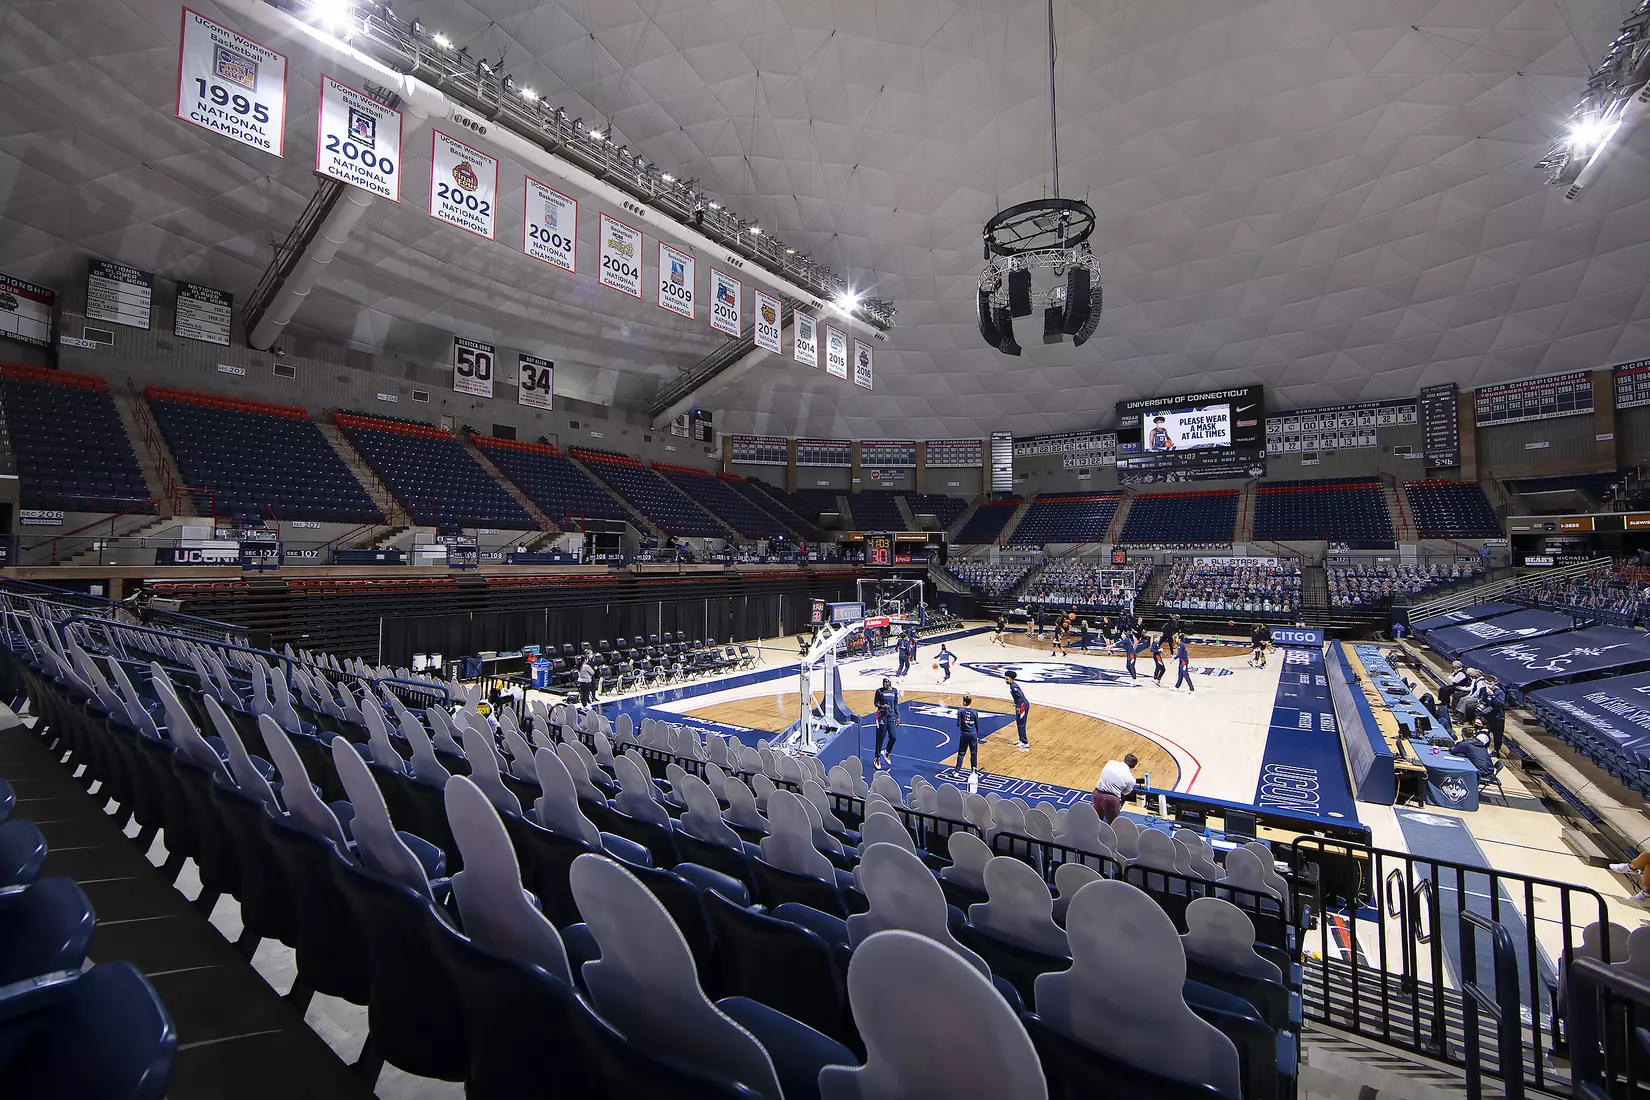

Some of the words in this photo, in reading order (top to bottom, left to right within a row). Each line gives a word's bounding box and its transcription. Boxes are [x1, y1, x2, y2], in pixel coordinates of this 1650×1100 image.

[195, 16, 230, 38] UConn
[233, 35, 277, 61] Women's
[210, 33, 263, 63] Basketball
[195, 78, 269, 123] 1995
[330, 81, 357, 99] UConn
[360, 95, 394, 117] Women's
[342, 96, 383, 119] Basketball
[197, 102, 265, 135] NATIONAL
[190, 112, 270, 148] CHAMPIONS
[326, 134, 394, 174] 2000
[440, 135, 462, 149] UConn
[464, 146, 492, 164] Women's
[450, 147, 483, 167] Basketball
[334, 157, 386, 184] NATIONAL
[454, 170, 474, 183] Final
[328, 166, 390, 196] CHAMPIONS
[458, 179, 477, 191] Four
[438, 183, 490, 216] 2002
[531, 181, 548, 194] UConn
[550, 190, 572, 204] Women's
[538, 192, 565, 207] Basketball
[442, 202, 485, 224] NATIONAL
[438, 210, 487, 234] CHAMPIONS
[604, 217, 619, 228] UConn
[529, 224, 571, 252] 2003
[611, 226, 633, 239] Basketball
[533, 241, 567, 260] NATIONAL
[530, 249, 570, 268] CHAMPIONS
[101, 262, 141, 276] NATIONAL
[106, 269, 137, 279] PLAYER
[603, 255, 638, 280] 2004
[108, 273, 124, 281] THE
[127, 278, 147, 287] YEAR
[606, 271, 635, 286] NATIONAL
[188, 284, 222, 296] NATIONAL
[604, 278, 637, 294] CHAMPIONS
[661, 281, 691, 302] 2009
[192, 289, 219, 299] PLAYER
[665, 295, 689, 309] NATIONAL
[663, 302, 690, 317] CHAMPIONS
[714, 303, 737, 321] 2010
[713, 321, 737, 335] CHAMPIONS
[715, 316, 736, 328] NATIONAL
[758, 323, 778, 338] 2013
[7, 333, 48, 347] BASKETBALL
[75, 339, 95, 349] 206
[797, 339, 815, 353] 2014
[457, 348, 491, 380] 50
[829, 353, 844, 366] 2015
[229, 367, 245, 375] 207
[856, 366, 871, 378] 2016
[521, 364, 551, 395] 34
[1481, 385, 1505, 393] NCAA
[1509, 373, 1585, 389] CHAMPIONSHIP
[1480, 387, 1527, 397] TOURNAMENT
[1530, 378, 1586, 390] APPEARANCES
[1507, 393, 1521, 401] 2003
[1540, 388, 1555, 396] 2005
[1126, 398, 1173, 409] UNIVERSITY
[1174, 396, 1186, 404] OF
[1187, 389, 1248, 402] CONNECTICUT
[1508, 401, 1521, 409] 2012
[1524, 399, 1538, 407] 2014
[1179, 416, 1204, 426] PLEASE
[1205, 414, 1227, 423] WEAR
[1322, 420, 1334, 428] 13
[1362, 417, 1371, 425] 34
[1382, 415, 1391, 423] 32
[1402, 413, 1412, 421] 50
[1181, 432, 1191, 440] AT
[1192, 431, 1204, 439] ALL
[1205, 429, 1226, 438] TIMES
[1190, 424, 1196, 432] A
[1197, 423, 1216, 431] MASK
[1268, 425, 1280, 433] 52
[1104, 440, 1114, 448] 42
[1271, 443, 1278, 451] 15
[1288, 442, 1296, 450] 22
[1324, 439, 1333, 447] 42
[1343, 437, 1352, 446] 13
[1365, 436, 1370, 444] 3
[1259, 450, 1265, 458] 0
[1064, 459, 1074, 467] 24
[38, 510, 63, 518] 206
[259, 549, 278, 557] 107
[300, 550, 318, 558] 107
[872, 548, 889, 564] 30
[1211, 558, 1259, 566] ALL-STARS
[843, 609, 860, 618] CITGO
[1272, 631, 1316, 643] CITGO
[1259, 763, 1320, 817] UCON
